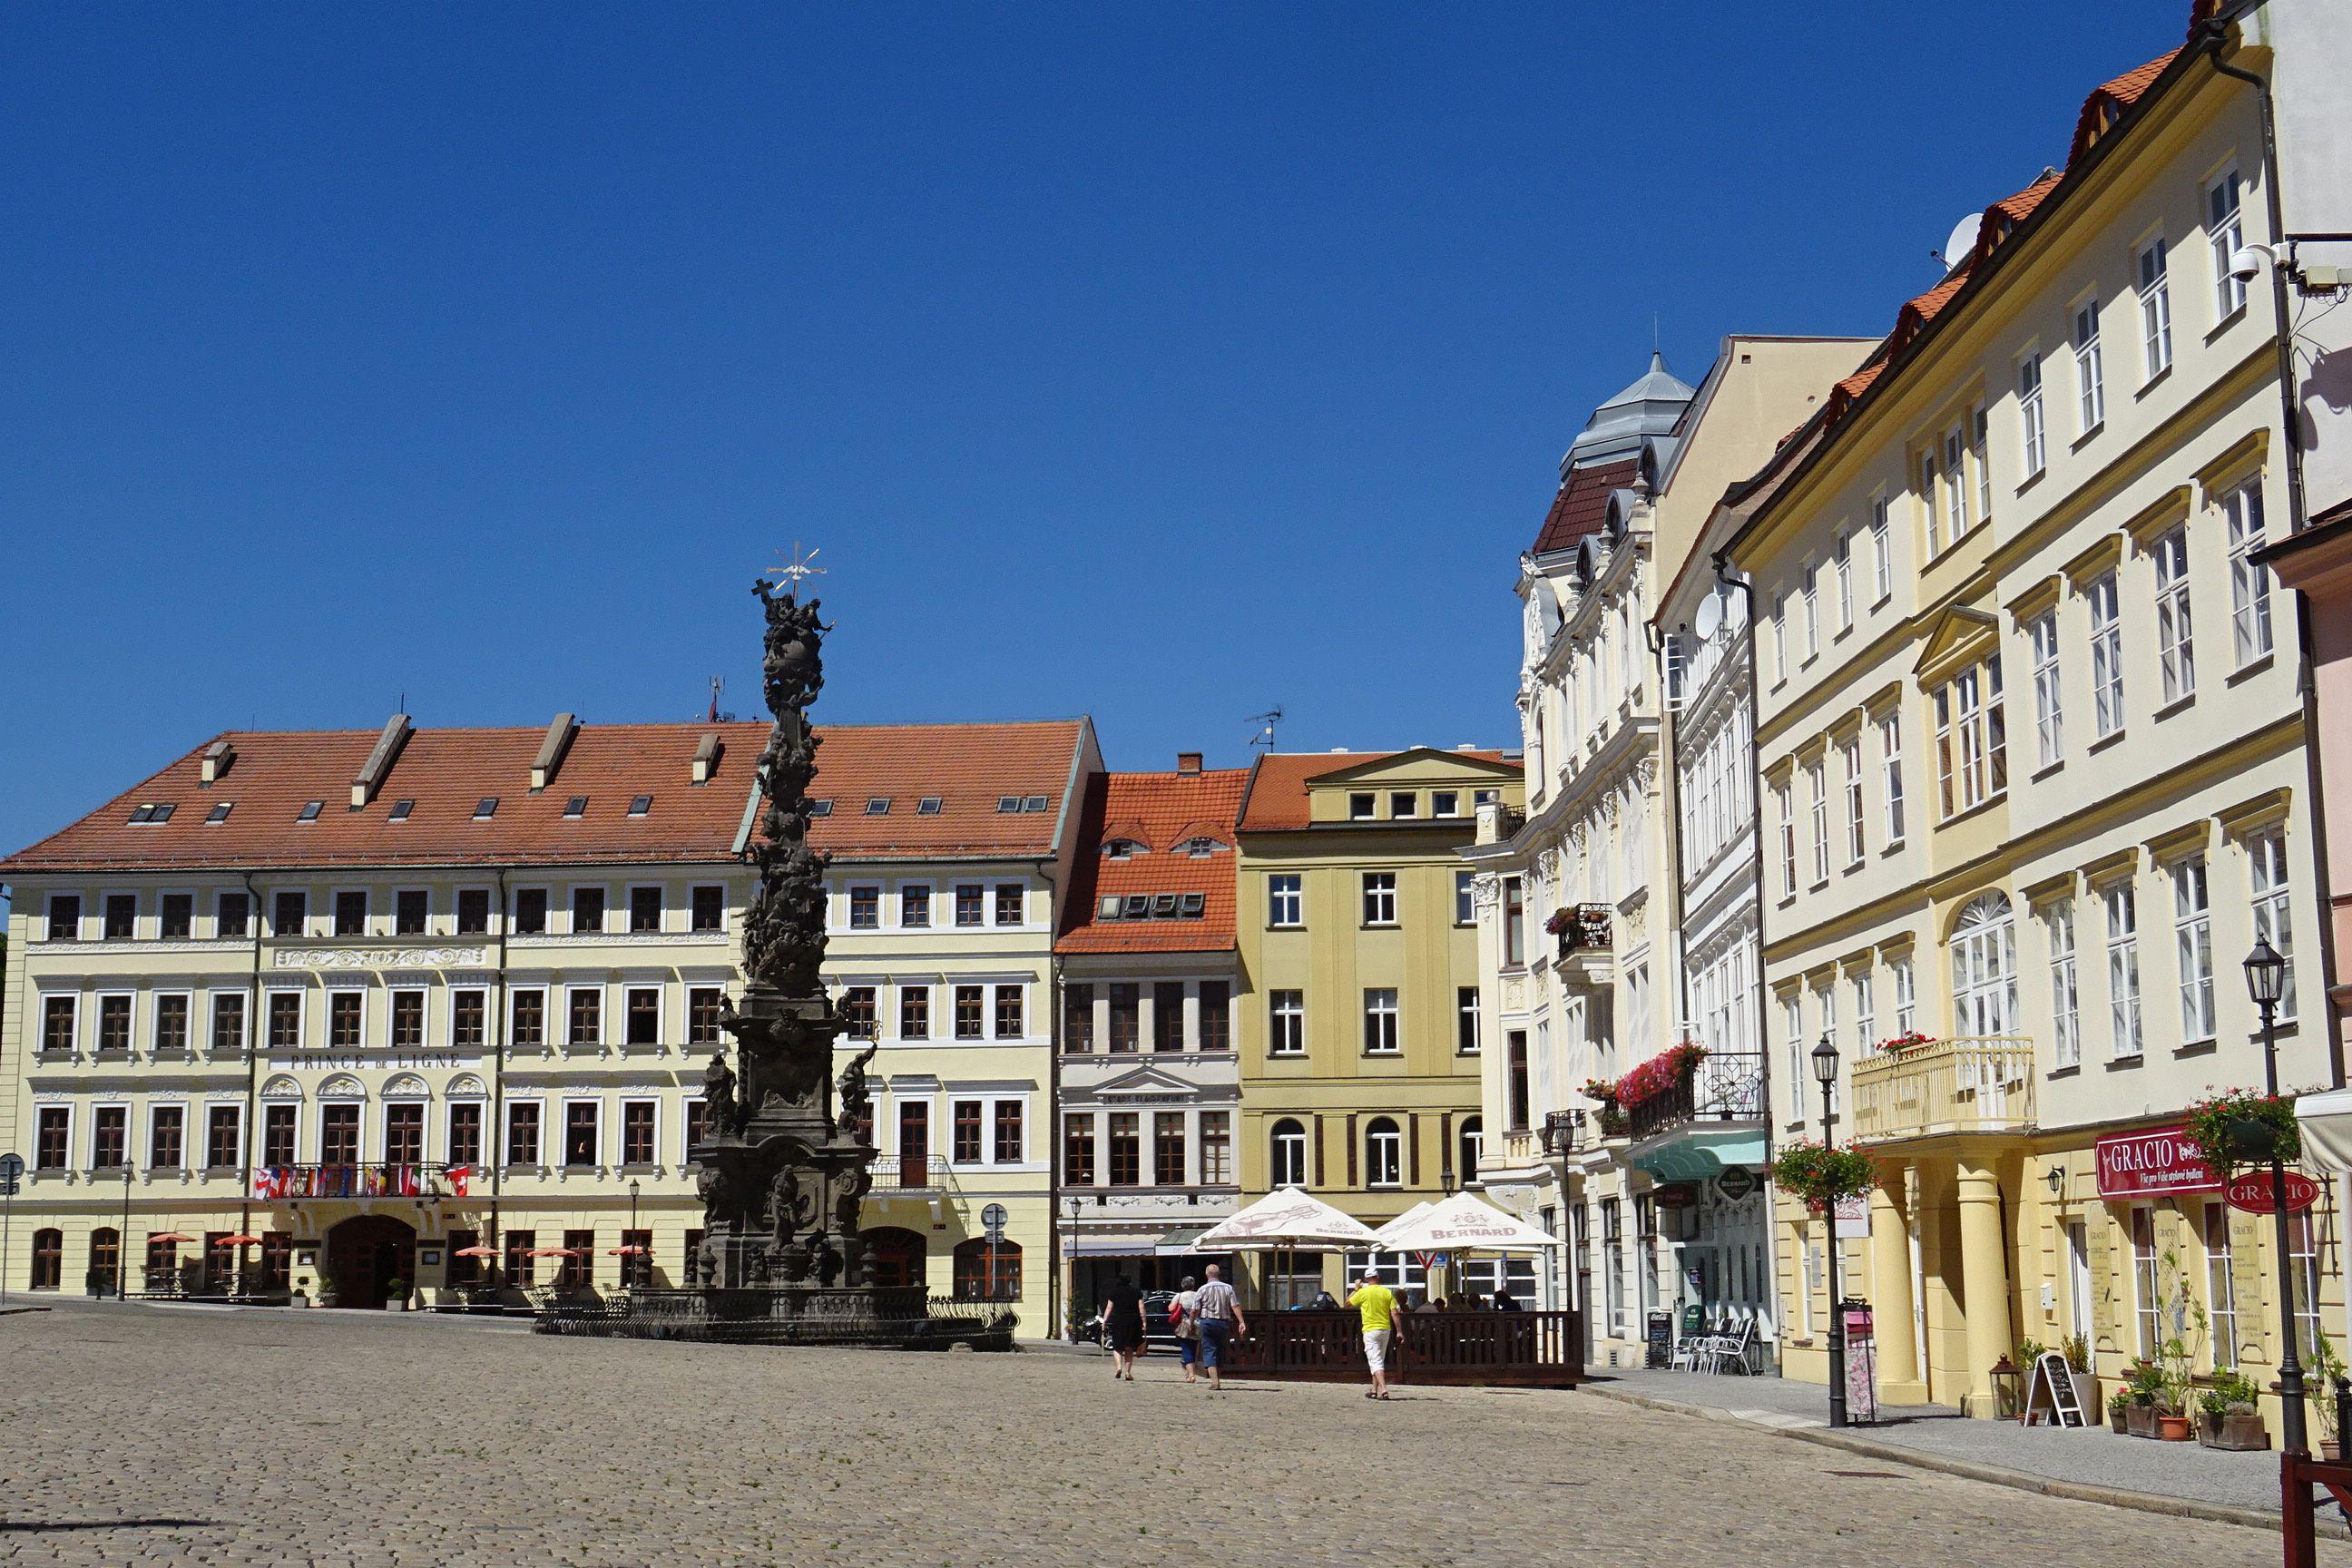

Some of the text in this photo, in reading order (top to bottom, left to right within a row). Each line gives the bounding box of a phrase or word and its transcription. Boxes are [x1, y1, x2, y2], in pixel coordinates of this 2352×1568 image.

[290, 1053, 461, 1070] PRINCE DE LIGNE
[2111, 1139, 2173, 1173] GRACIO
[1316, 1227, 1363, 1236] BERNARD
[1430, 1227, 1517, 1240] BERNARD
